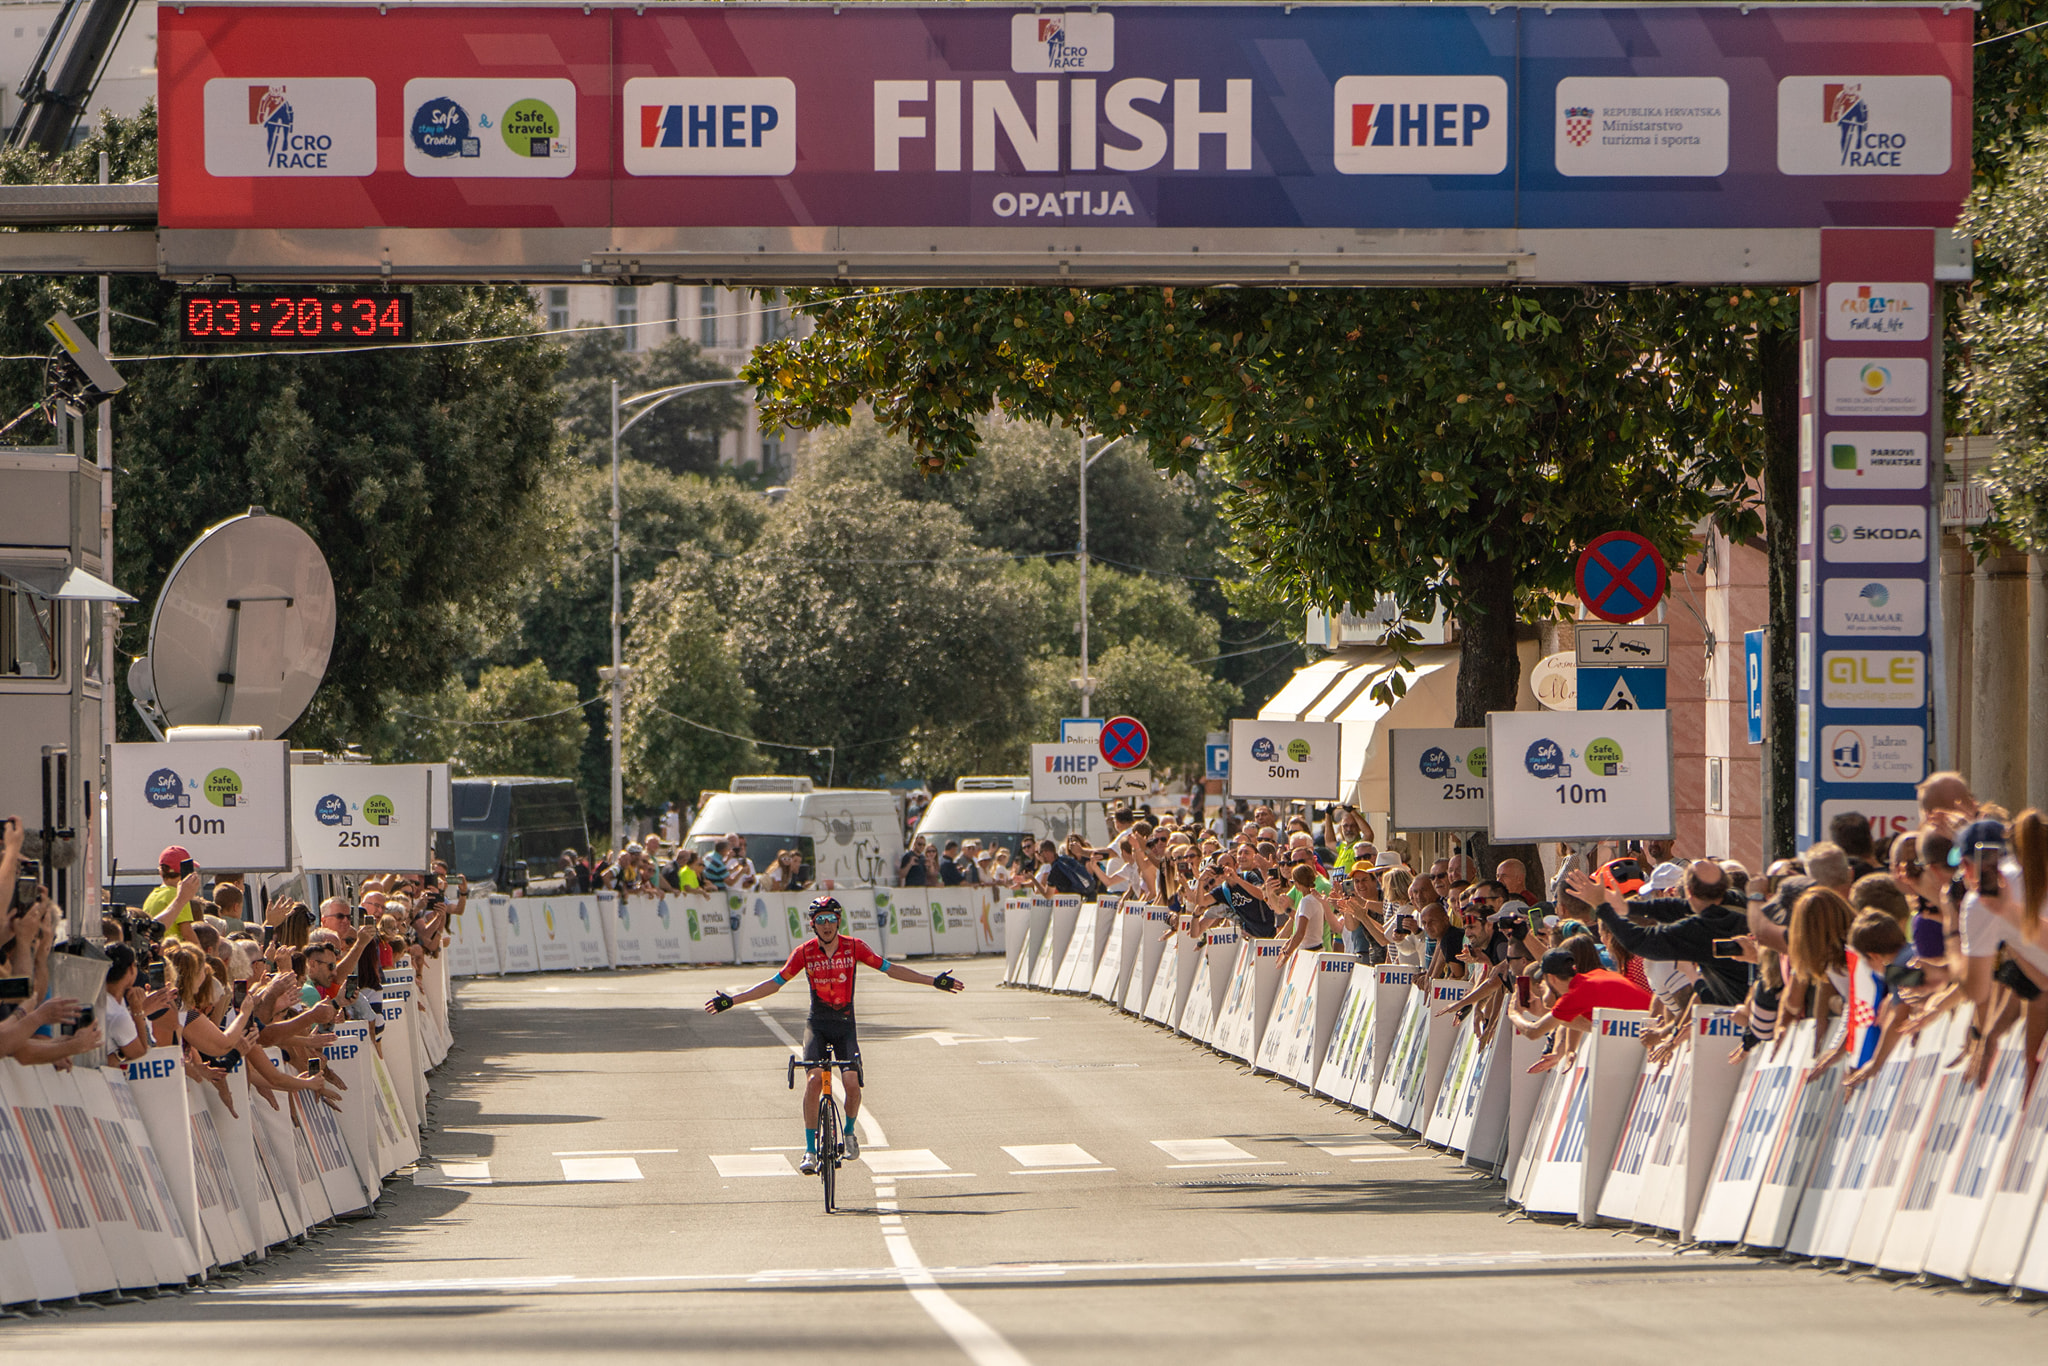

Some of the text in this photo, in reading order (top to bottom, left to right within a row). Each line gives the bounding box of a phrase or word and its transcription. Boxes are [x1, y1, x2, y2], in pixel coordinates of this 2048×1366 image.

[1063, 47, 1087, 58] CRO
[1054, 57, 1085, 68] RACE
[432, 106, 459, 129] Safe
[515, 111, 544, 122] Safe
[1602, 108, 1721, 117] REPUBLIKA HRVATSKA
[508, 123, 554, 134] travels
[688, 104, 779, 148] HEP
[874, 77, 1252, 172] FINISH
[1400, 103, 1490, 148] HEP
[1602, 120, 1683, 131] Ministarstvo
[291, 135, 332, 151] CRO
[424, 134, 456, 146] Croatia
[1602, 134, 1700, 147] turizma i sporta
[1865, 133, 1906, 150] CRO
[276, 153, 328, 168] RACE
[1850, 151, 1902, 168] RACE
[992, 190, 1134, 217] OPATIJA
[1840, 297, 1911, 313] CROATIA
[188, 298, 404, 337] 03:20:34
[1870, 449, 1914, 457] PARKOVI
[1870, 458, 1922, 466] HRVATSKE
[1853, 526, 1922, 540] ŠKODA
[1844, 613, 1904, 623] VALAMAR
[1538, 744, 1556, 759] Safe
[1593, 745, 1613, 753] Safe
[1063, 755, 1098, 772] HEP
[1589, 753, 1619, 761] travels
[1268, 765, 1299, 778] 50m
[158, 774, 176, 789] Safe
[212, 776, 232, 784] Safe
[1057, 775, 1087, 785] 100m
[208, 784, 238, 792] travels
[1443, 784, 1484, 799] 25m
[1556, 784, 1606, 804] 10m
[326, 799, 341, 811] Safe
[175, 814, 225, 835] 10m
[338, 831, 380, 847] 25m
[1218, 933, 1239, 944] HEP
[807, 956, 853, 968] BAHRAIN
[331, 1045, 358, 1060] HEP
[138, 1059, 175, 1080] HEP
